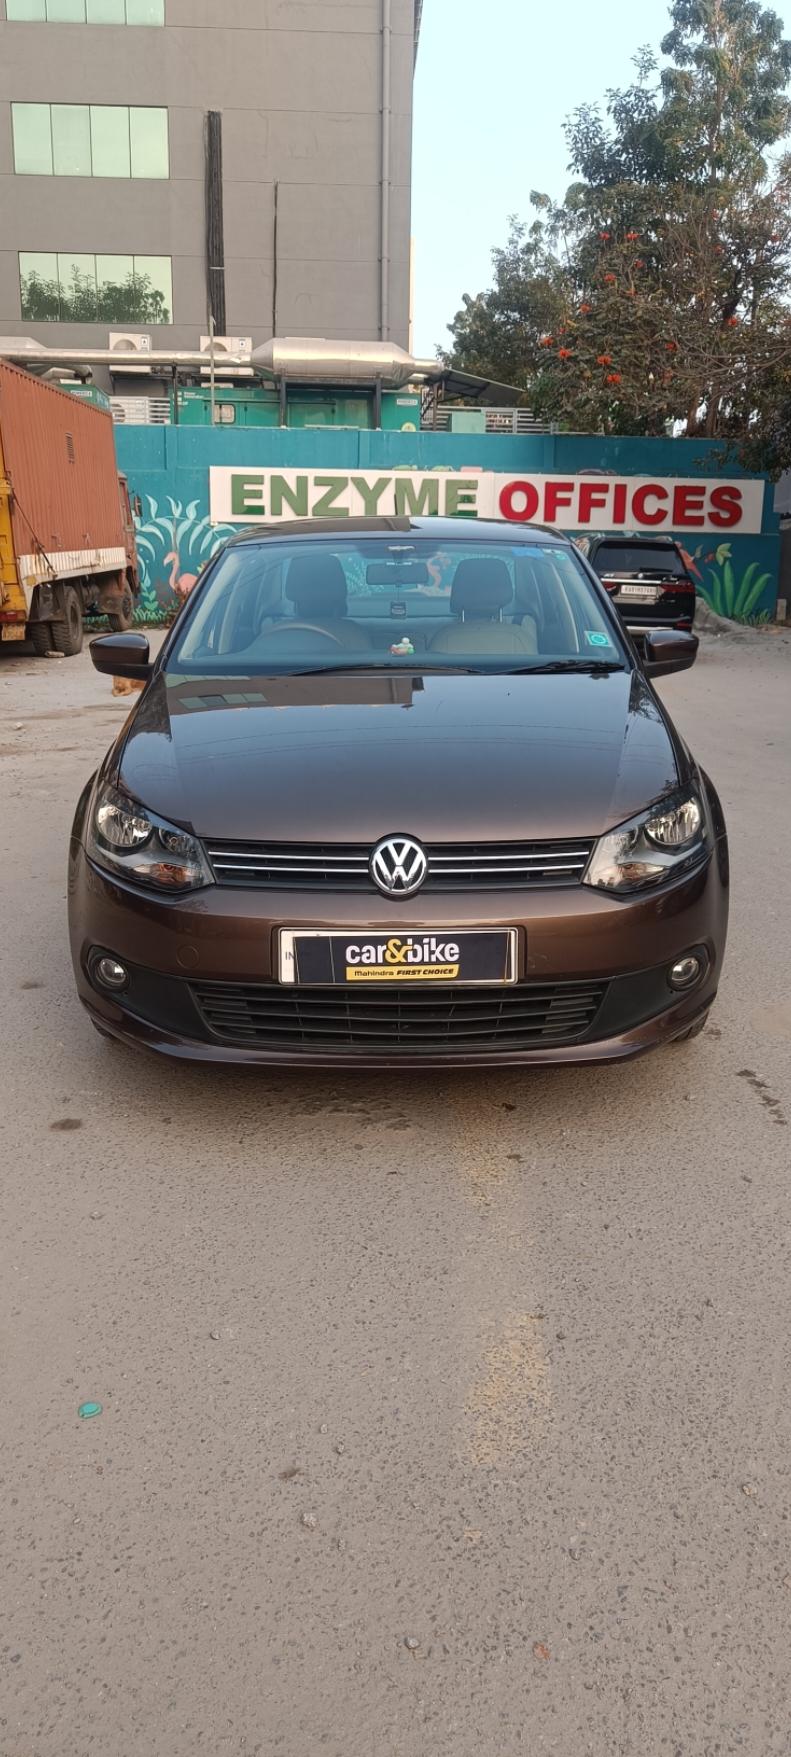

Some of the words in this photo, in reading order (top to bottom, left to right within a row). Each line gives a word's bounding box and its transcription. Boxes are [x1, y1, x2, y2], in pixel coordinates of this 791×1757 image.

[231, 474, 479, 517] ENZYME
[499, 480, 743, 528] OFFICES
[345, 938, 460, 964] car&bike
